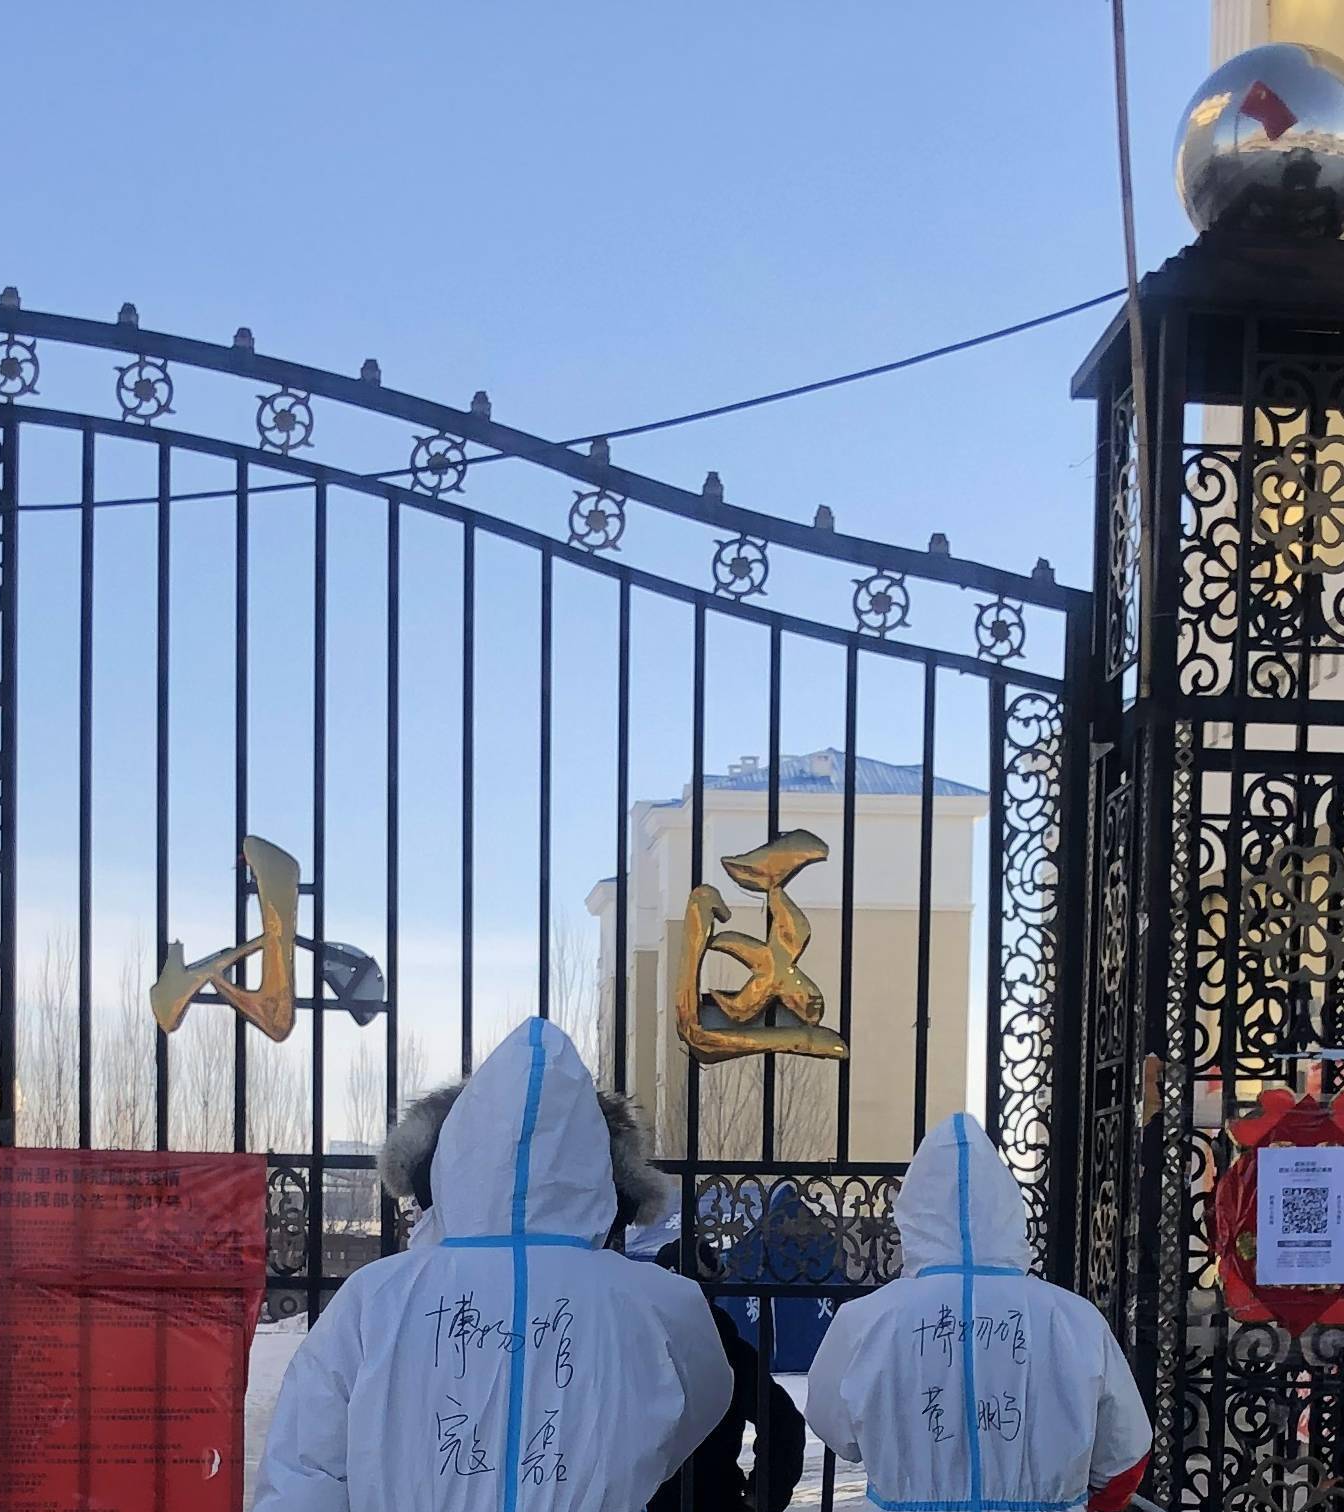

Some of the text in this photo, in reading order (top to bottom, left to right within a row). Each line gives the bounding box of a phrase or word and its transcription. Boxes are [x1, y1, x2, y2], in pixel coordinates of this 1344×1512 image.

[425, 1291, 573, 1388] 博物馆
[912, 1304, 1028, 1367] 博物馆
